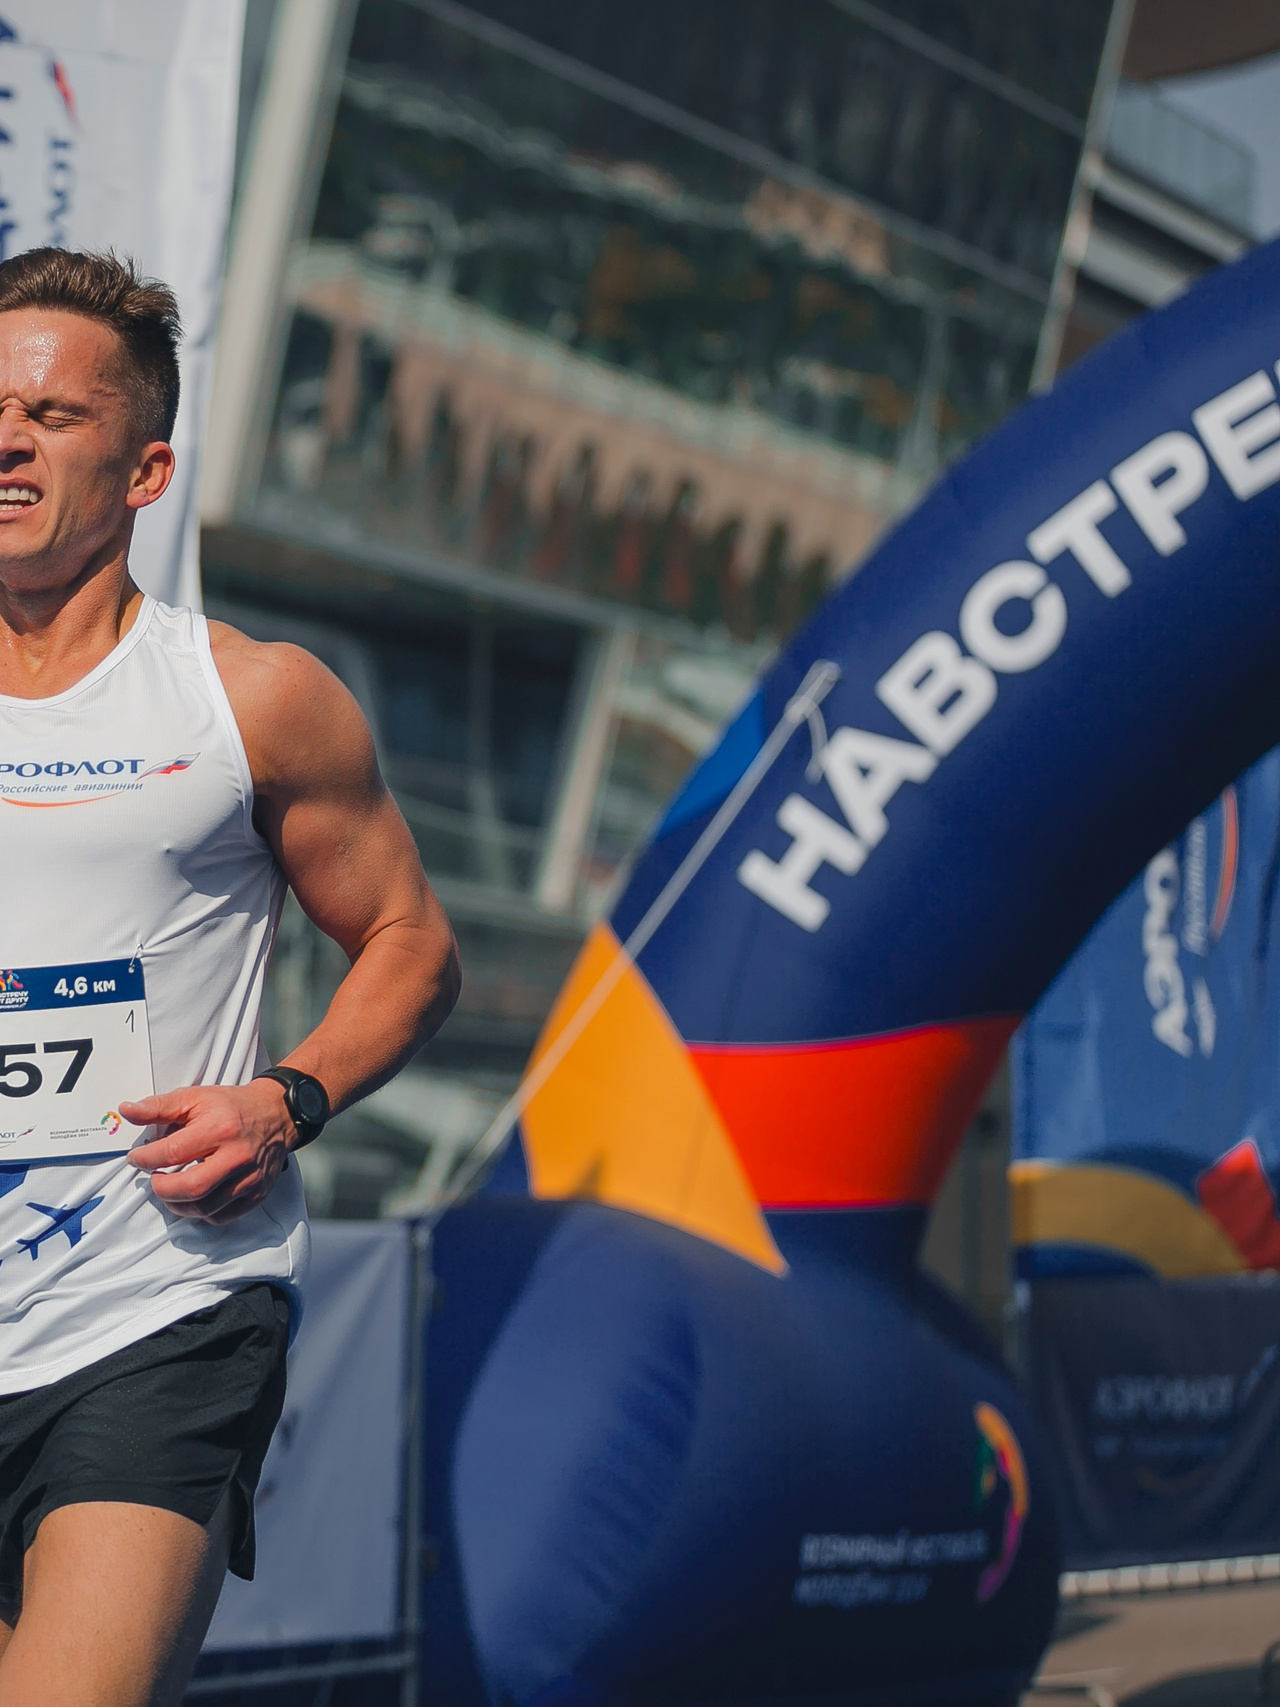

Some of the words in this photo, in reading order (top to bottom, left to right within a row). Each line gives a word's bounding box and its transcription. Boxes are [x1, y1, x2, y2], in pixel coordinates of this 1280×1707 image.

[736, 358, 1280, 935] НАВСТРЕ
[73, 781, 144, 792] авиалинии
[53, 976, 88, 999] 4,6
